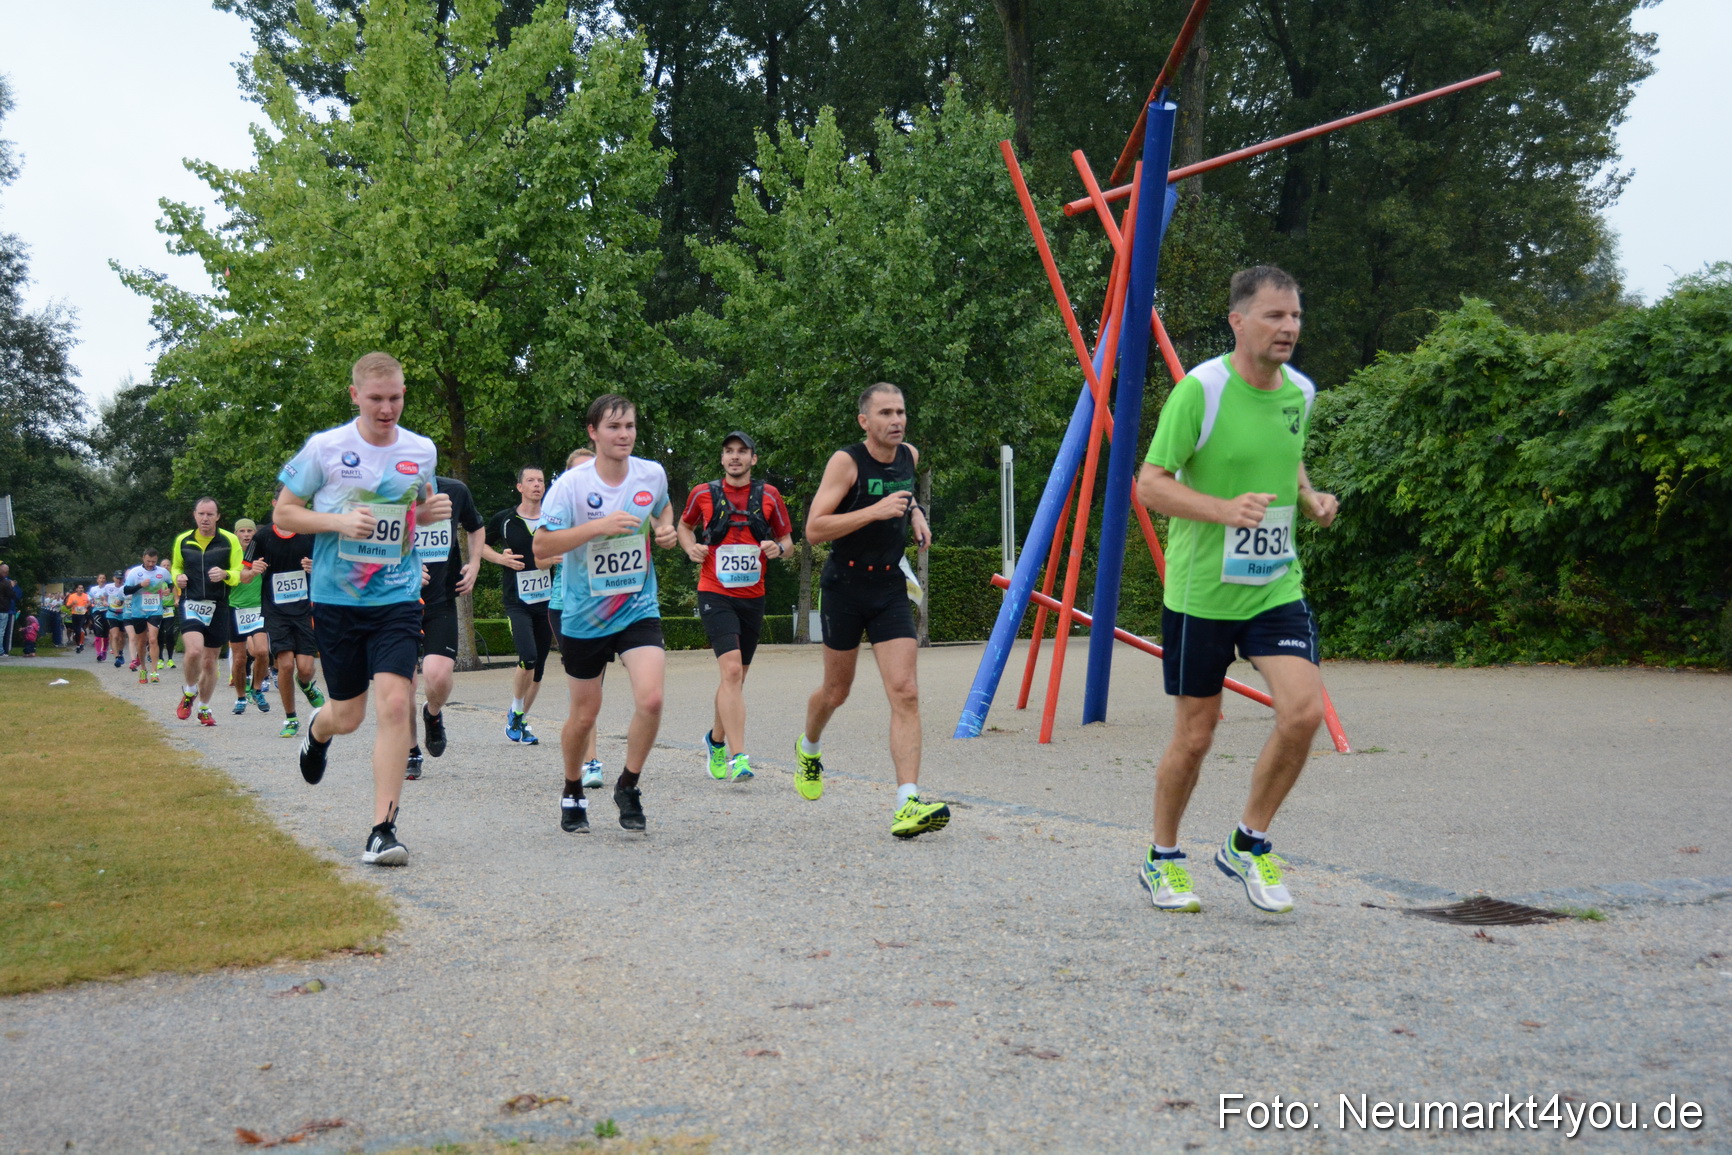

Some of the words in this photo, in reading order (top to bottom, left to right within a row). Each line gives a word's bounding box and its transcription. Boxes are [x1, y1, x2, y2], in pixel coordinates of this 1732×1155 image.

[414, 530, 449, 547] 2756
[1234, 526, 1289, 556] 2632
[358, 544, 387, 557] Martin
[594, 549, 643, 575] 2622
[721, 555, 758, 571] 2552
[276, 577, 304, 592] 2557
[521, 575, 550, 592] 2712
[605, 576, 637, 588] Andreas
[730, 574, 750, 582] Tobias
[143, 597, 159, 605] 3031
[1277, 639, 1307, 649] JAKO
